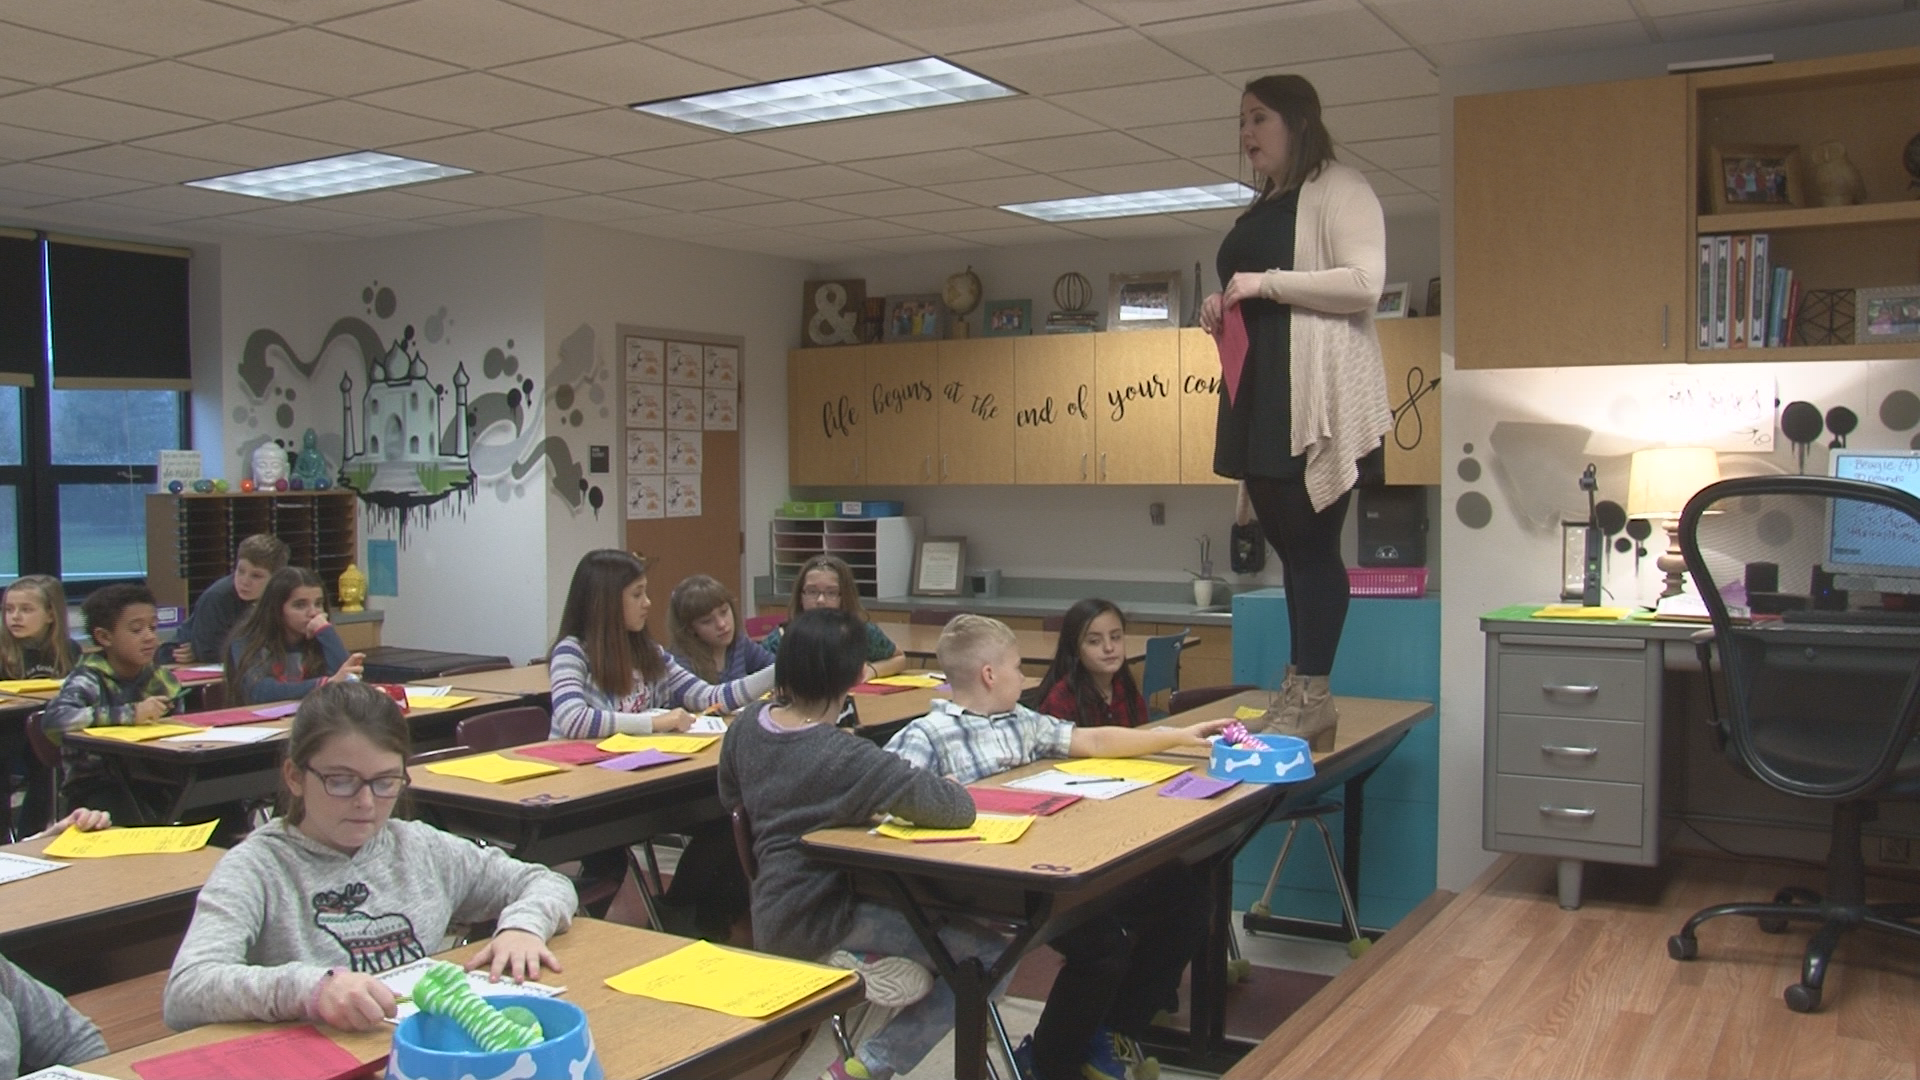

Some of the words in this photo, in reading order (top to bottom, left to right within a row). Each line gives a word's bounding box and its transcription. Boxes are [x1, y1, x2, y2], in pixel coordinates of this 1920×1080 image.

[823, 394, 860, 439] life
[872, 380, 933, 416] begins
[943, 380, 965, 405] at
[970, 392, 1001, 422] the
[1016, 396, 1058, 428] end
[1066, 383, 1089, 421] of
[1107, 373, 1170, 422] your
